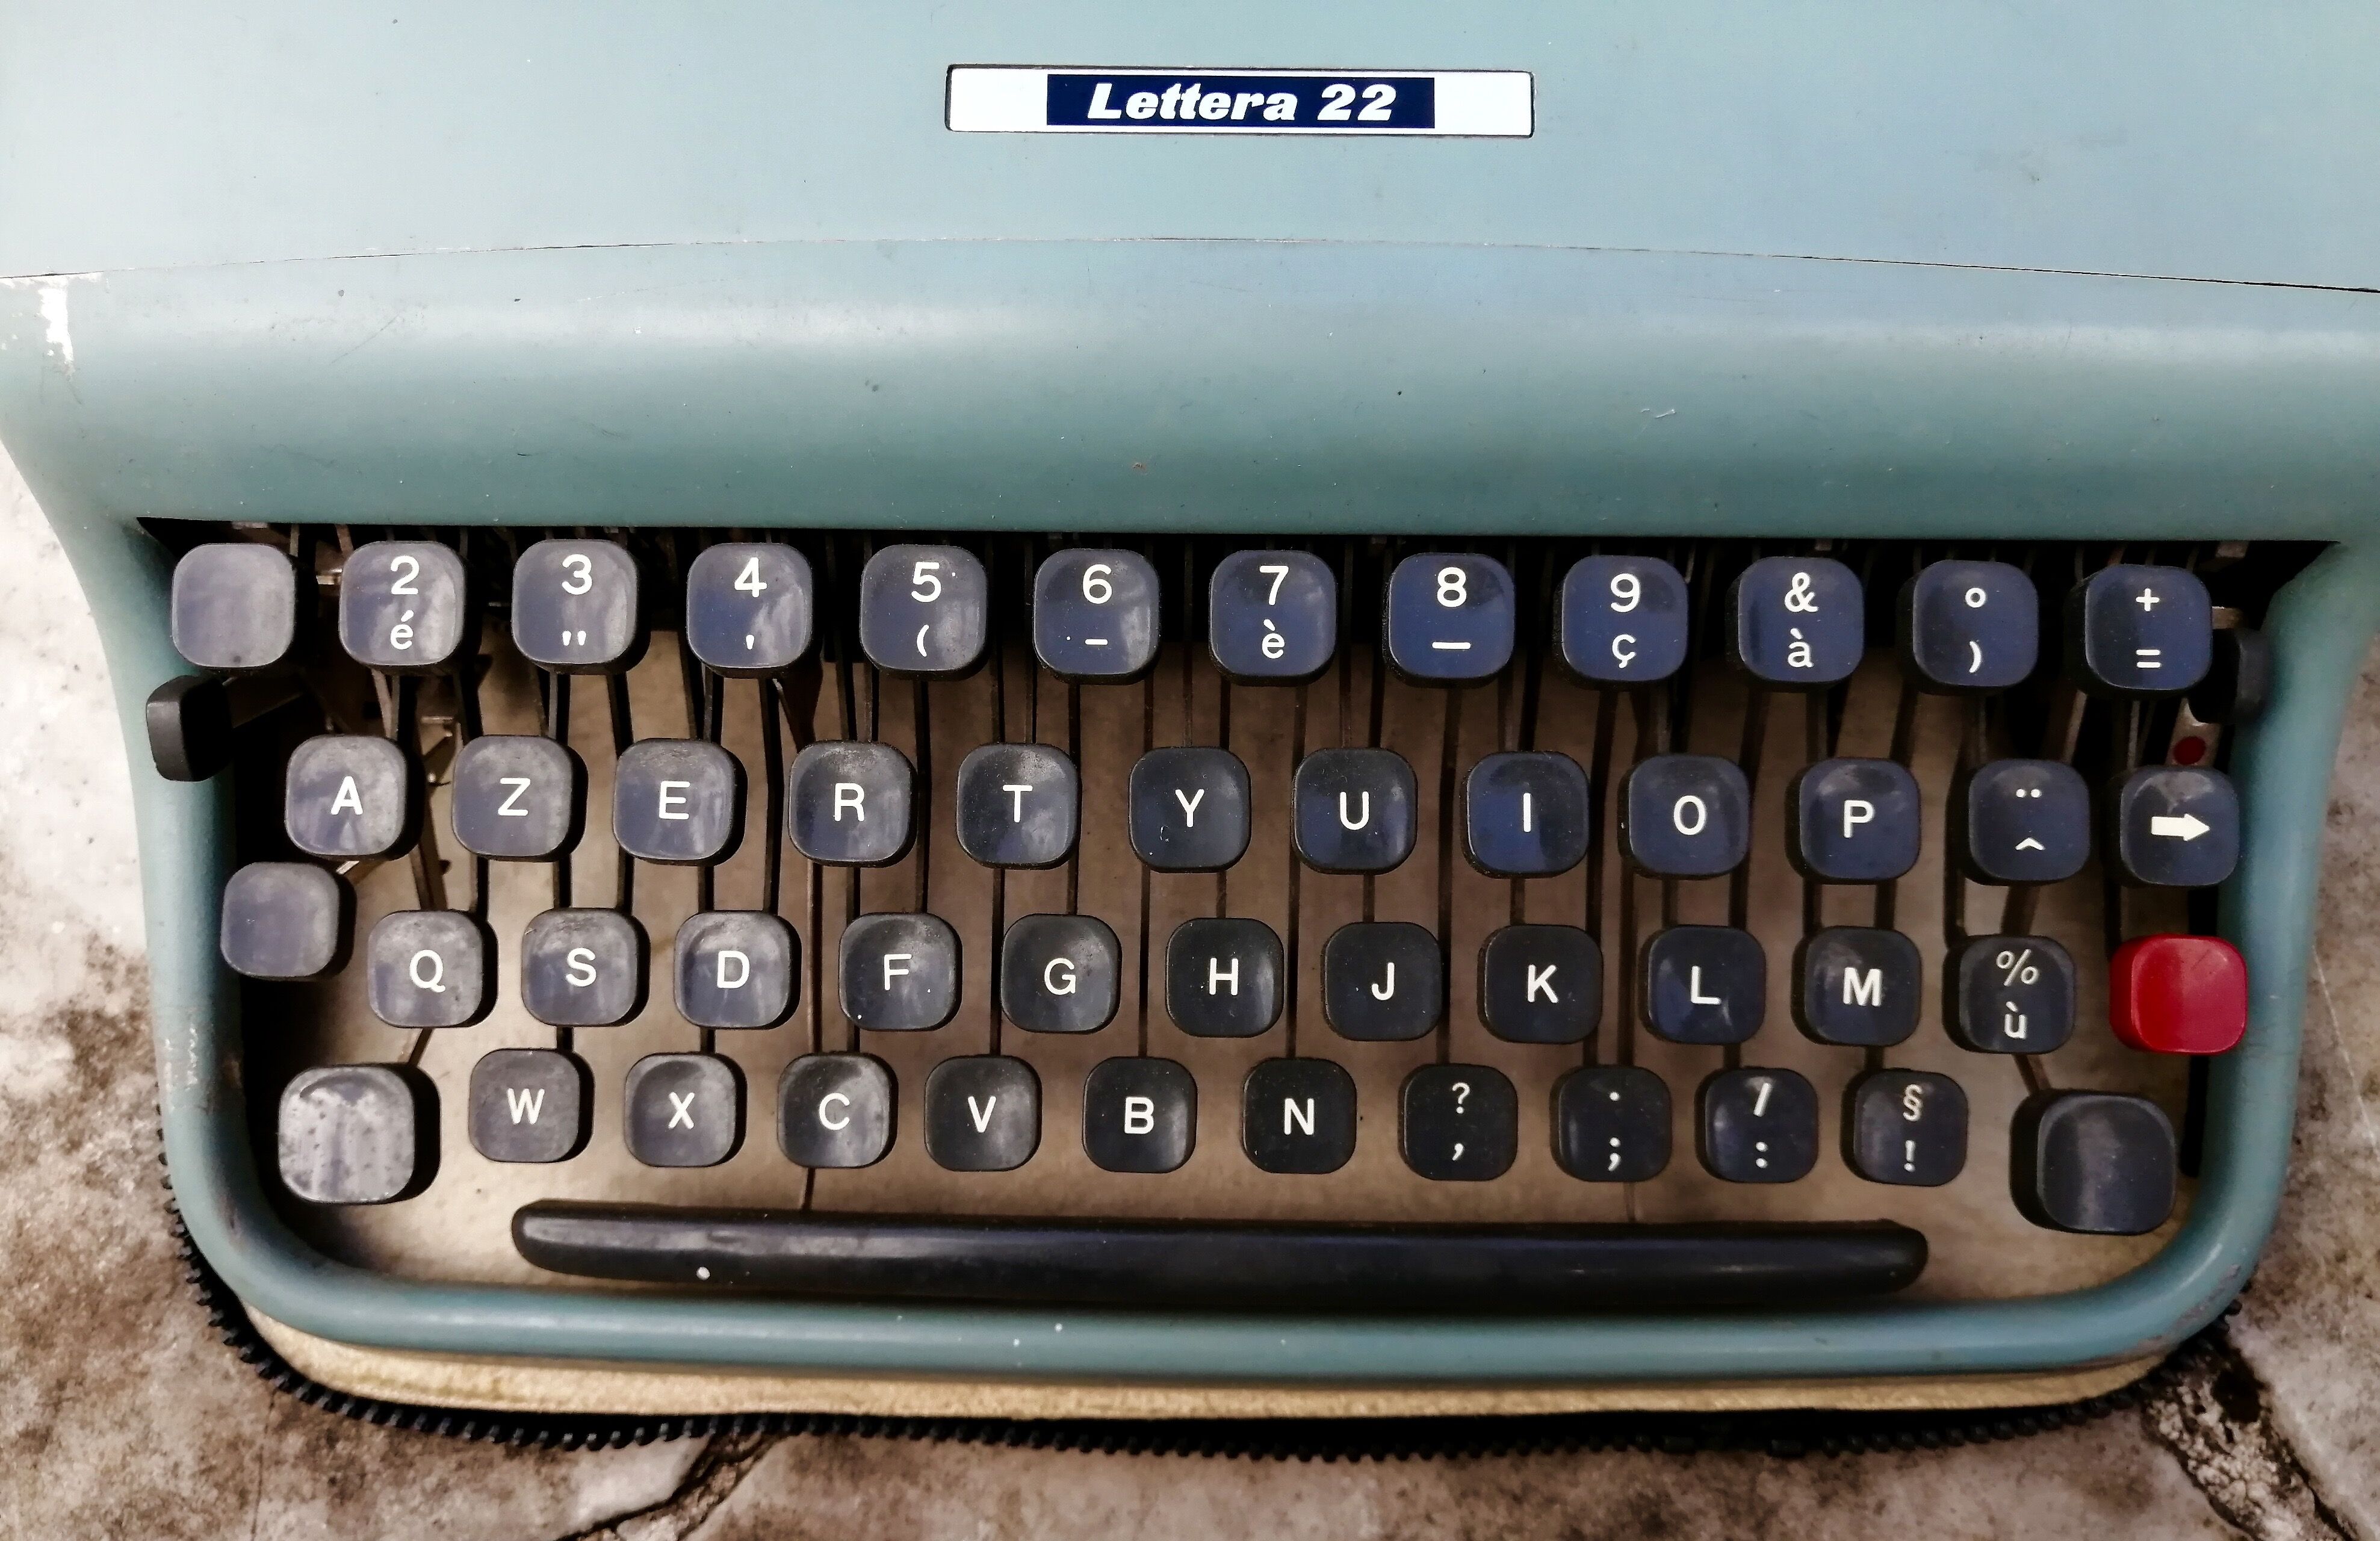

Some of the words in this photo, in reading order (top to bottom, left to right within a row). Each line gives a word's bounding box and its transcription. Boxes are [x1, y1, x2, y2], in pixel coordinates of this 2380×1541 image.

[1086, 82, 1298, 122] Lettera
[1316, 82, 1397, 122] 22
[389, 554, 420, 595] 2
[561, 553, 593, 596] 3
[733, 556, 768, 598] 4
[910, 560, 942, 603] 5
[1082, 563, 1113, 605] 6
[1259, 565, 1290, 606] 7
[1436, 566, 1467, 608] 8
[1610, 572, 1641, 613] 9
[1783, 571, 1819, 613] &
[2135, 587, 2161, 612] +
[389, 609, 415, 651] é
[916, 624, 930, 658] (
[1261, 618, 1286, 660] è
[1787, 627, 1814, 668] à
[1611, 633, 1637, 669] ç
[1968, 640, 1982, 674] )
[2135, 648, 2162, 669] =
[330, 775, 364, 816] A
[497, 777, 531, 817] Z
[658, 780, 692, 820] E
[832, 782, 866, 822] R
[1002, 783, 1034, 823] T
[1174, 788, 1206, 828] Y
[1339, 790, 1370, 831] U
[1522, 792, 1532, 833] I
[1843, 799, 1875, 839] P
[408, 949, 447, 993] Q
[565, 946, 597, 988] S
[716, 949, 751, 989] D
[883, 952, 913, 991] F
[1043, 957, 1077, 996] G
[1208, 957, 1239, 996] H
[1371, 961, 1395, 1001] J
[1526, 964, 1560, 1004] K
[1690, 965, 1721, 1005] L
[1842, 966, 1882, 1007] M
[1996, 948, 2039, 987] %
[2003, 1000, 2027, 1040] ù
[506, 1087, 546, 1126] W
[668, 1091, 696, 1130] X
[818, 1091, 851, 1131] C
[967, 1095, 997, 1133] V
[1124, 1096, 1155, 1135] B
[1283, 1097, 1315, 1136] N
[1451, 1082, 1470, 1114] ?
[1753, 1082, 1772, 1117] /
[1902, 1084, 1923, 1122] §
[1607, 1136, 1620, 1171] ;
[1755, 1141, 1768, 1168] :
[1903, 1139, 1916, 1172] !
